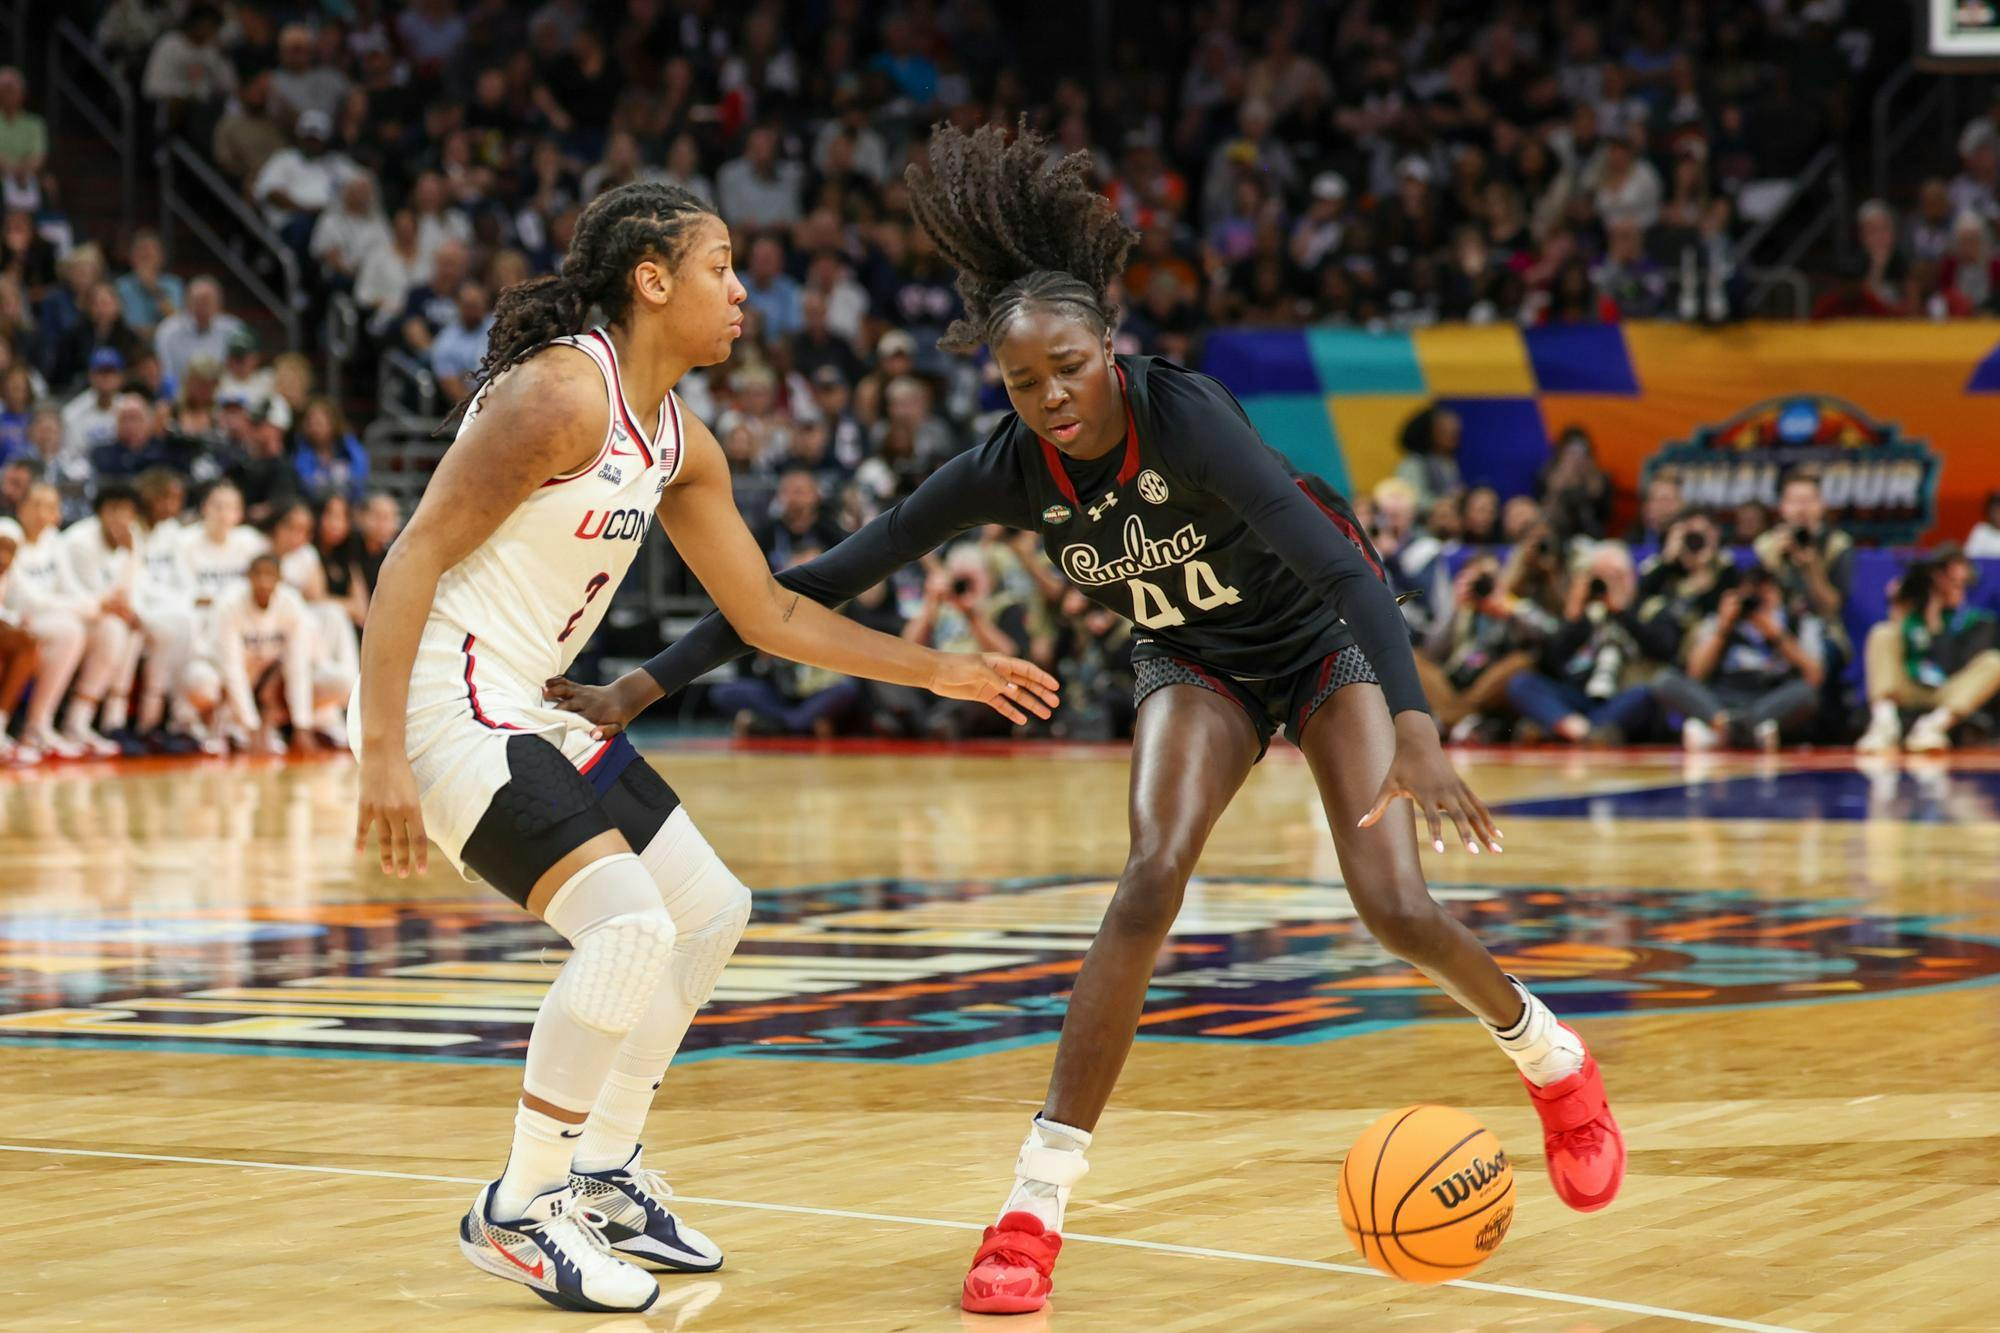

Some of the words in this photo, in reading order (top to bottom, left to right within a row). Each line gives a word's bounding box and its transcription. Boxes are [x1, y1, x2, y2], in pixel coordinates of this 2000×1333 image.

[603, 463, 612, 472] BE
[1140, 472, 1166, 502] SEC
[574, 508, 652, 543] UCON
[1060, 514, 1207, 586] Carolina
[1127, 559, 1243, 631] 44
